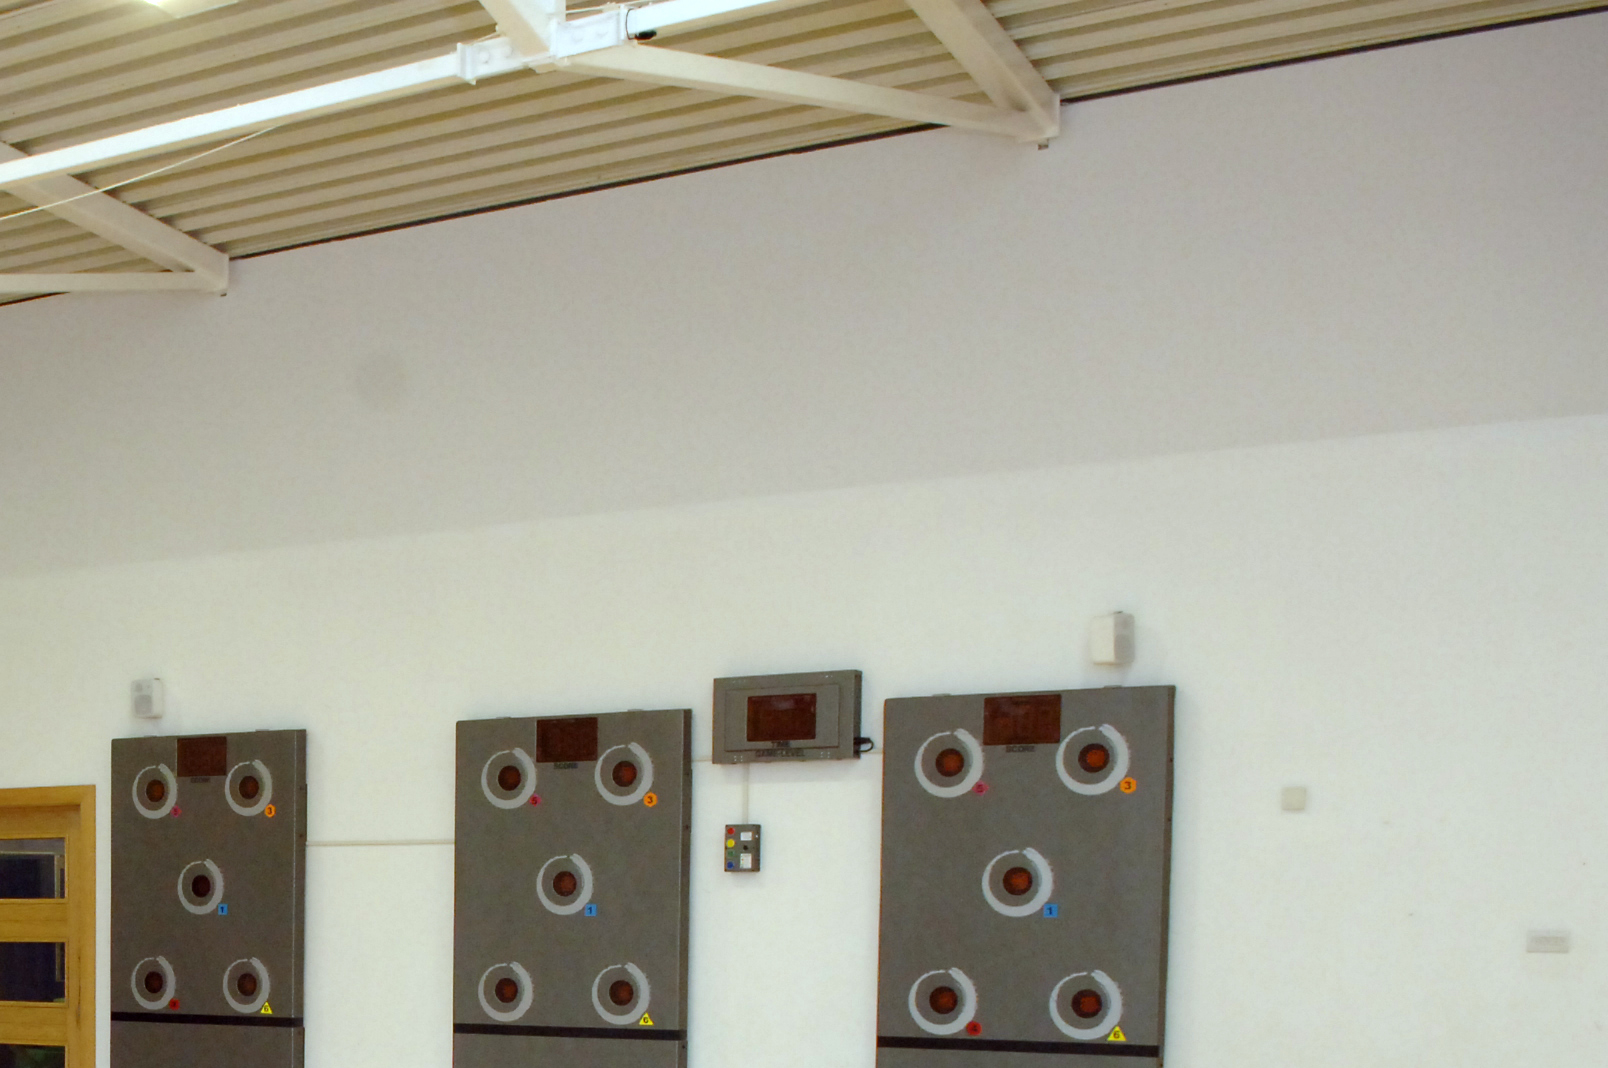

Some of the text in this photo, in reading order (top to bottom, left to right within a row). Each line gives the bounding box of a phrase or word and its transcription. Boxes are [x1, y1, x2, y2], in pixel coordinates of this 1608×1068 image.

[1006, 745, 1036, 753] SCORE
[977, 784, 983, 793] 5
[1124, 781, 1132, 790] 3
[647, 796, 654, 804] 3
[588, 906, 593, 914] 1
[1047, 907, 1053, 915] 1
[643, 1016, 649, 1024] 6
[1113, 1030, 1120, 1039] 6
